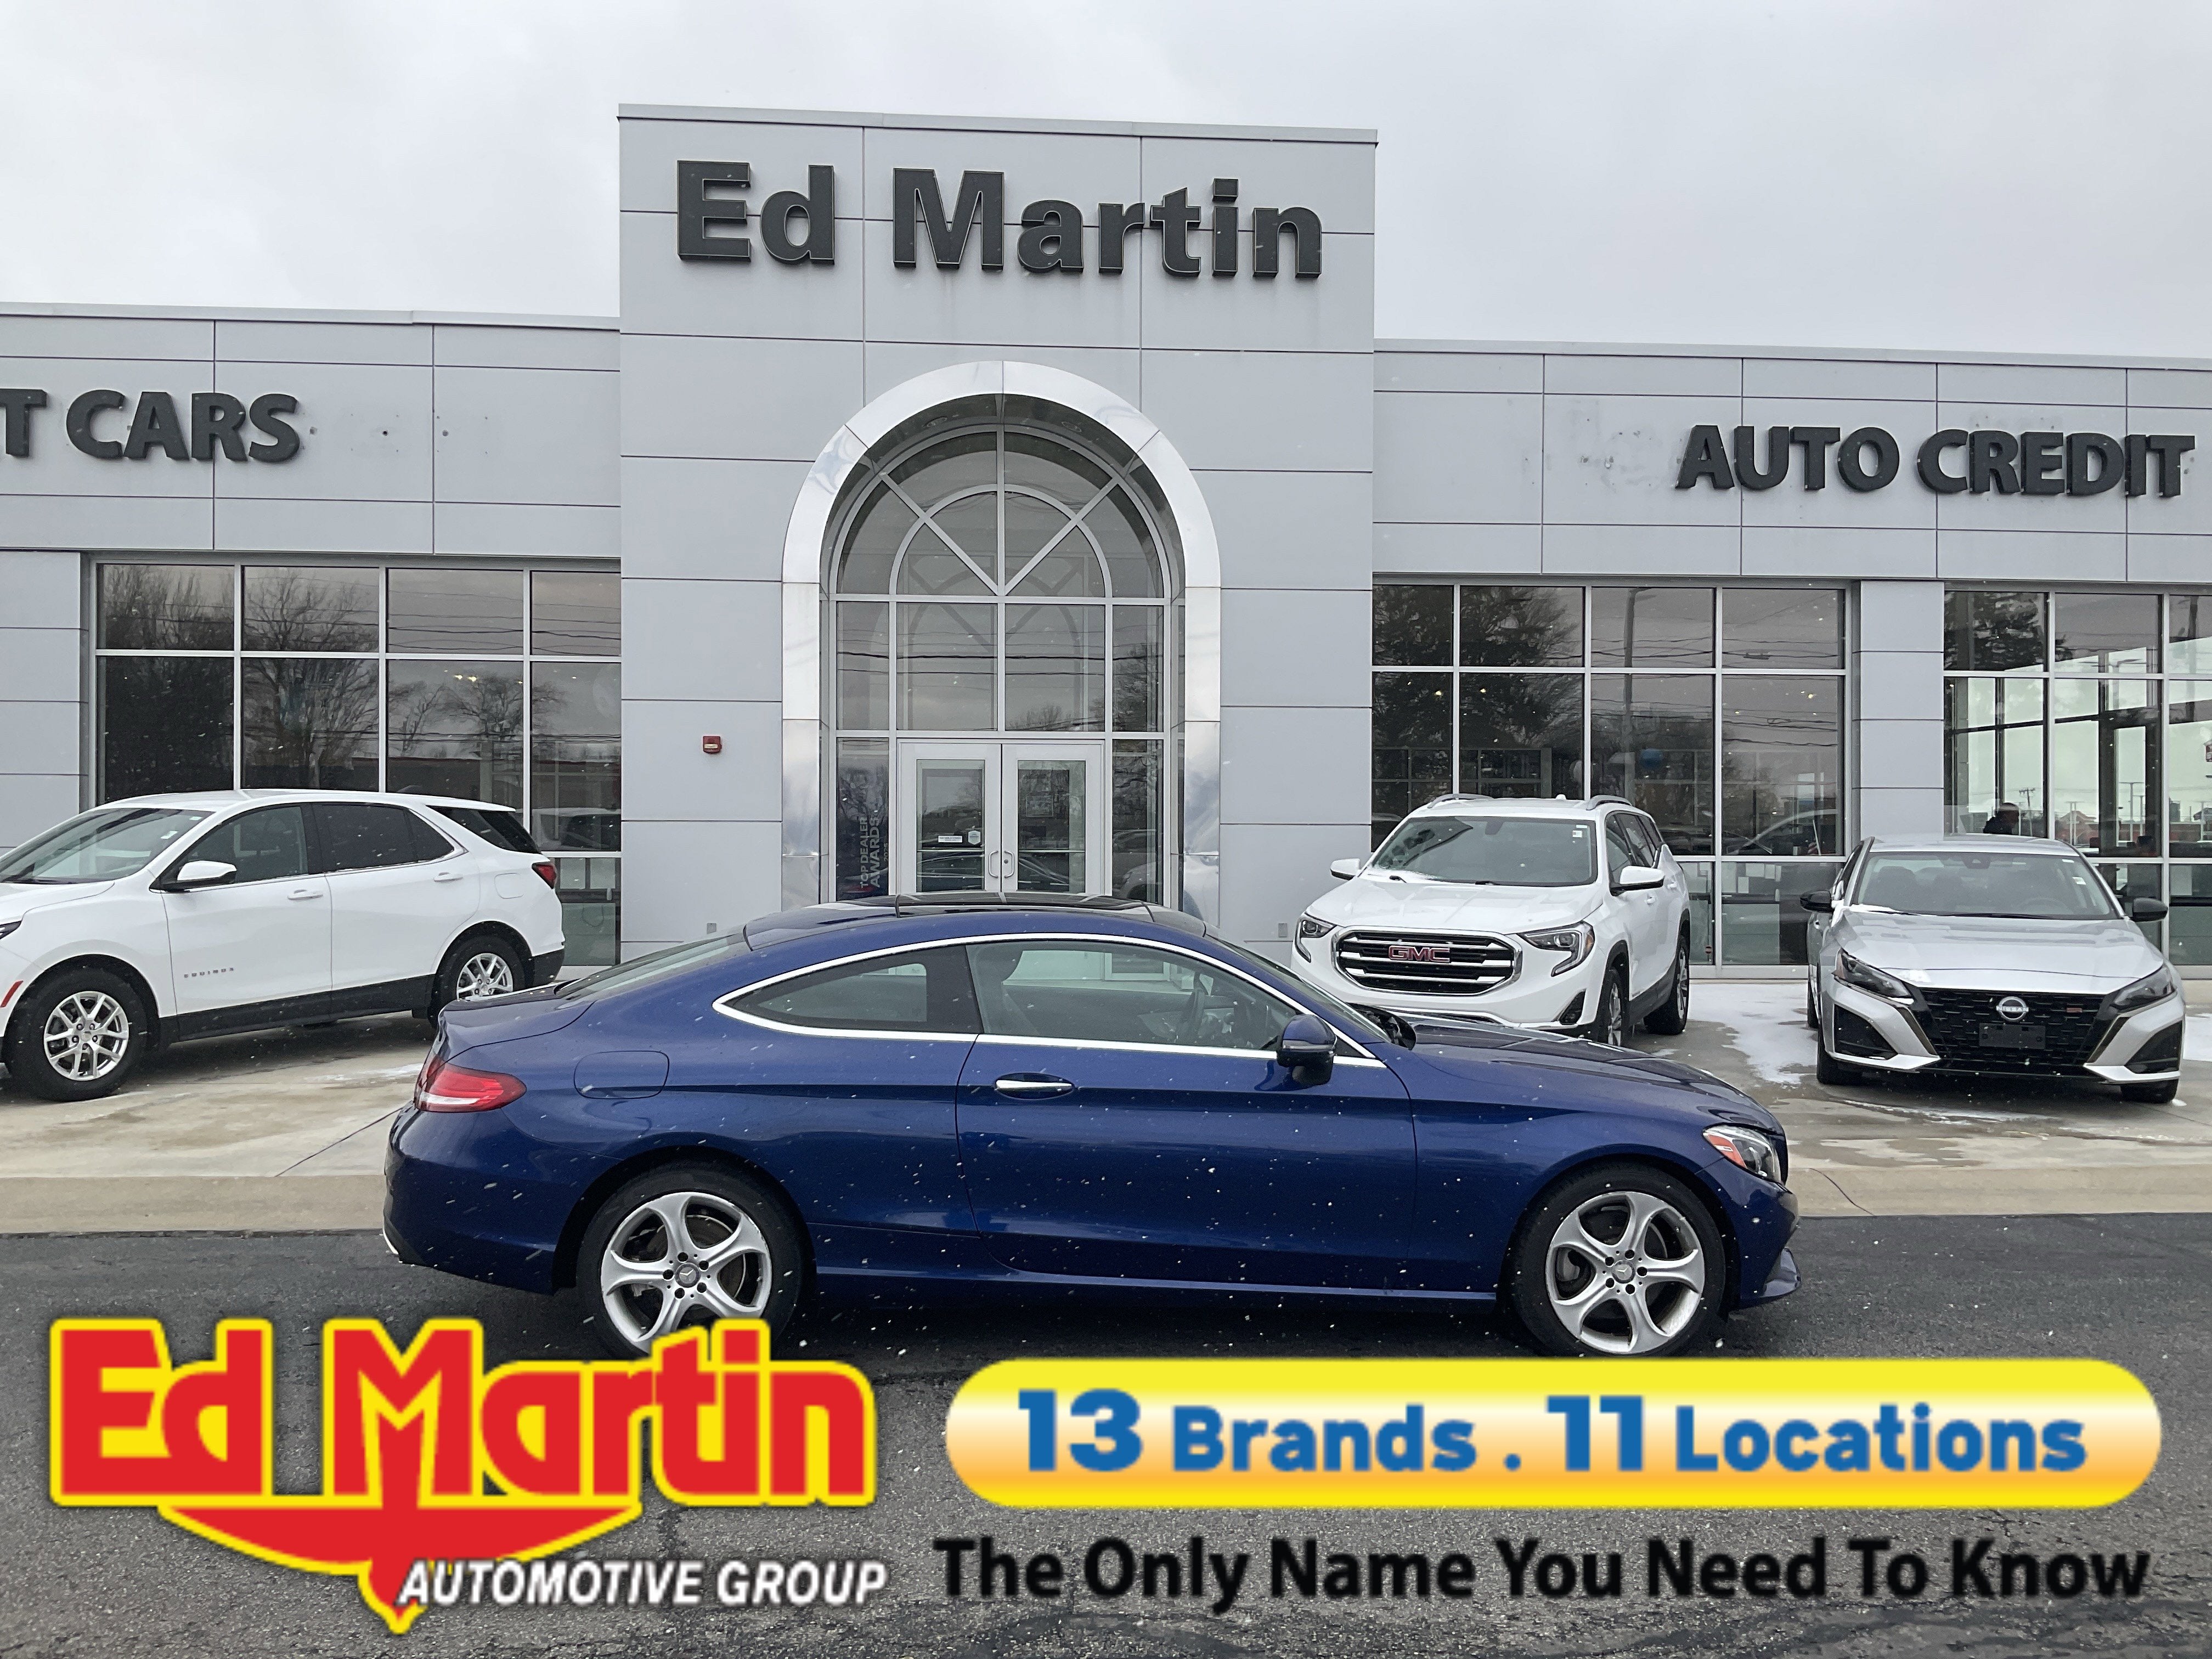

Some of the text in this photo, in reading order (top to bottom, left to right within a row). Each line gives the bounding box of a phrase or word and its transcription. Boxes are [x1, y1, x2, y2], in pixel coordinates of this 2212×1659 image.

[677, 160, 1322, 279] Ed Martin
[0, 388, 300, 463] T CARS
[1675, 425, 2195, 498] AUTO CREDIT
[860, 817, 868, 889] TOP DEALER
[870, 816, 881, 888] AWARDS
[1389, 945, 1450, 963] GMC
